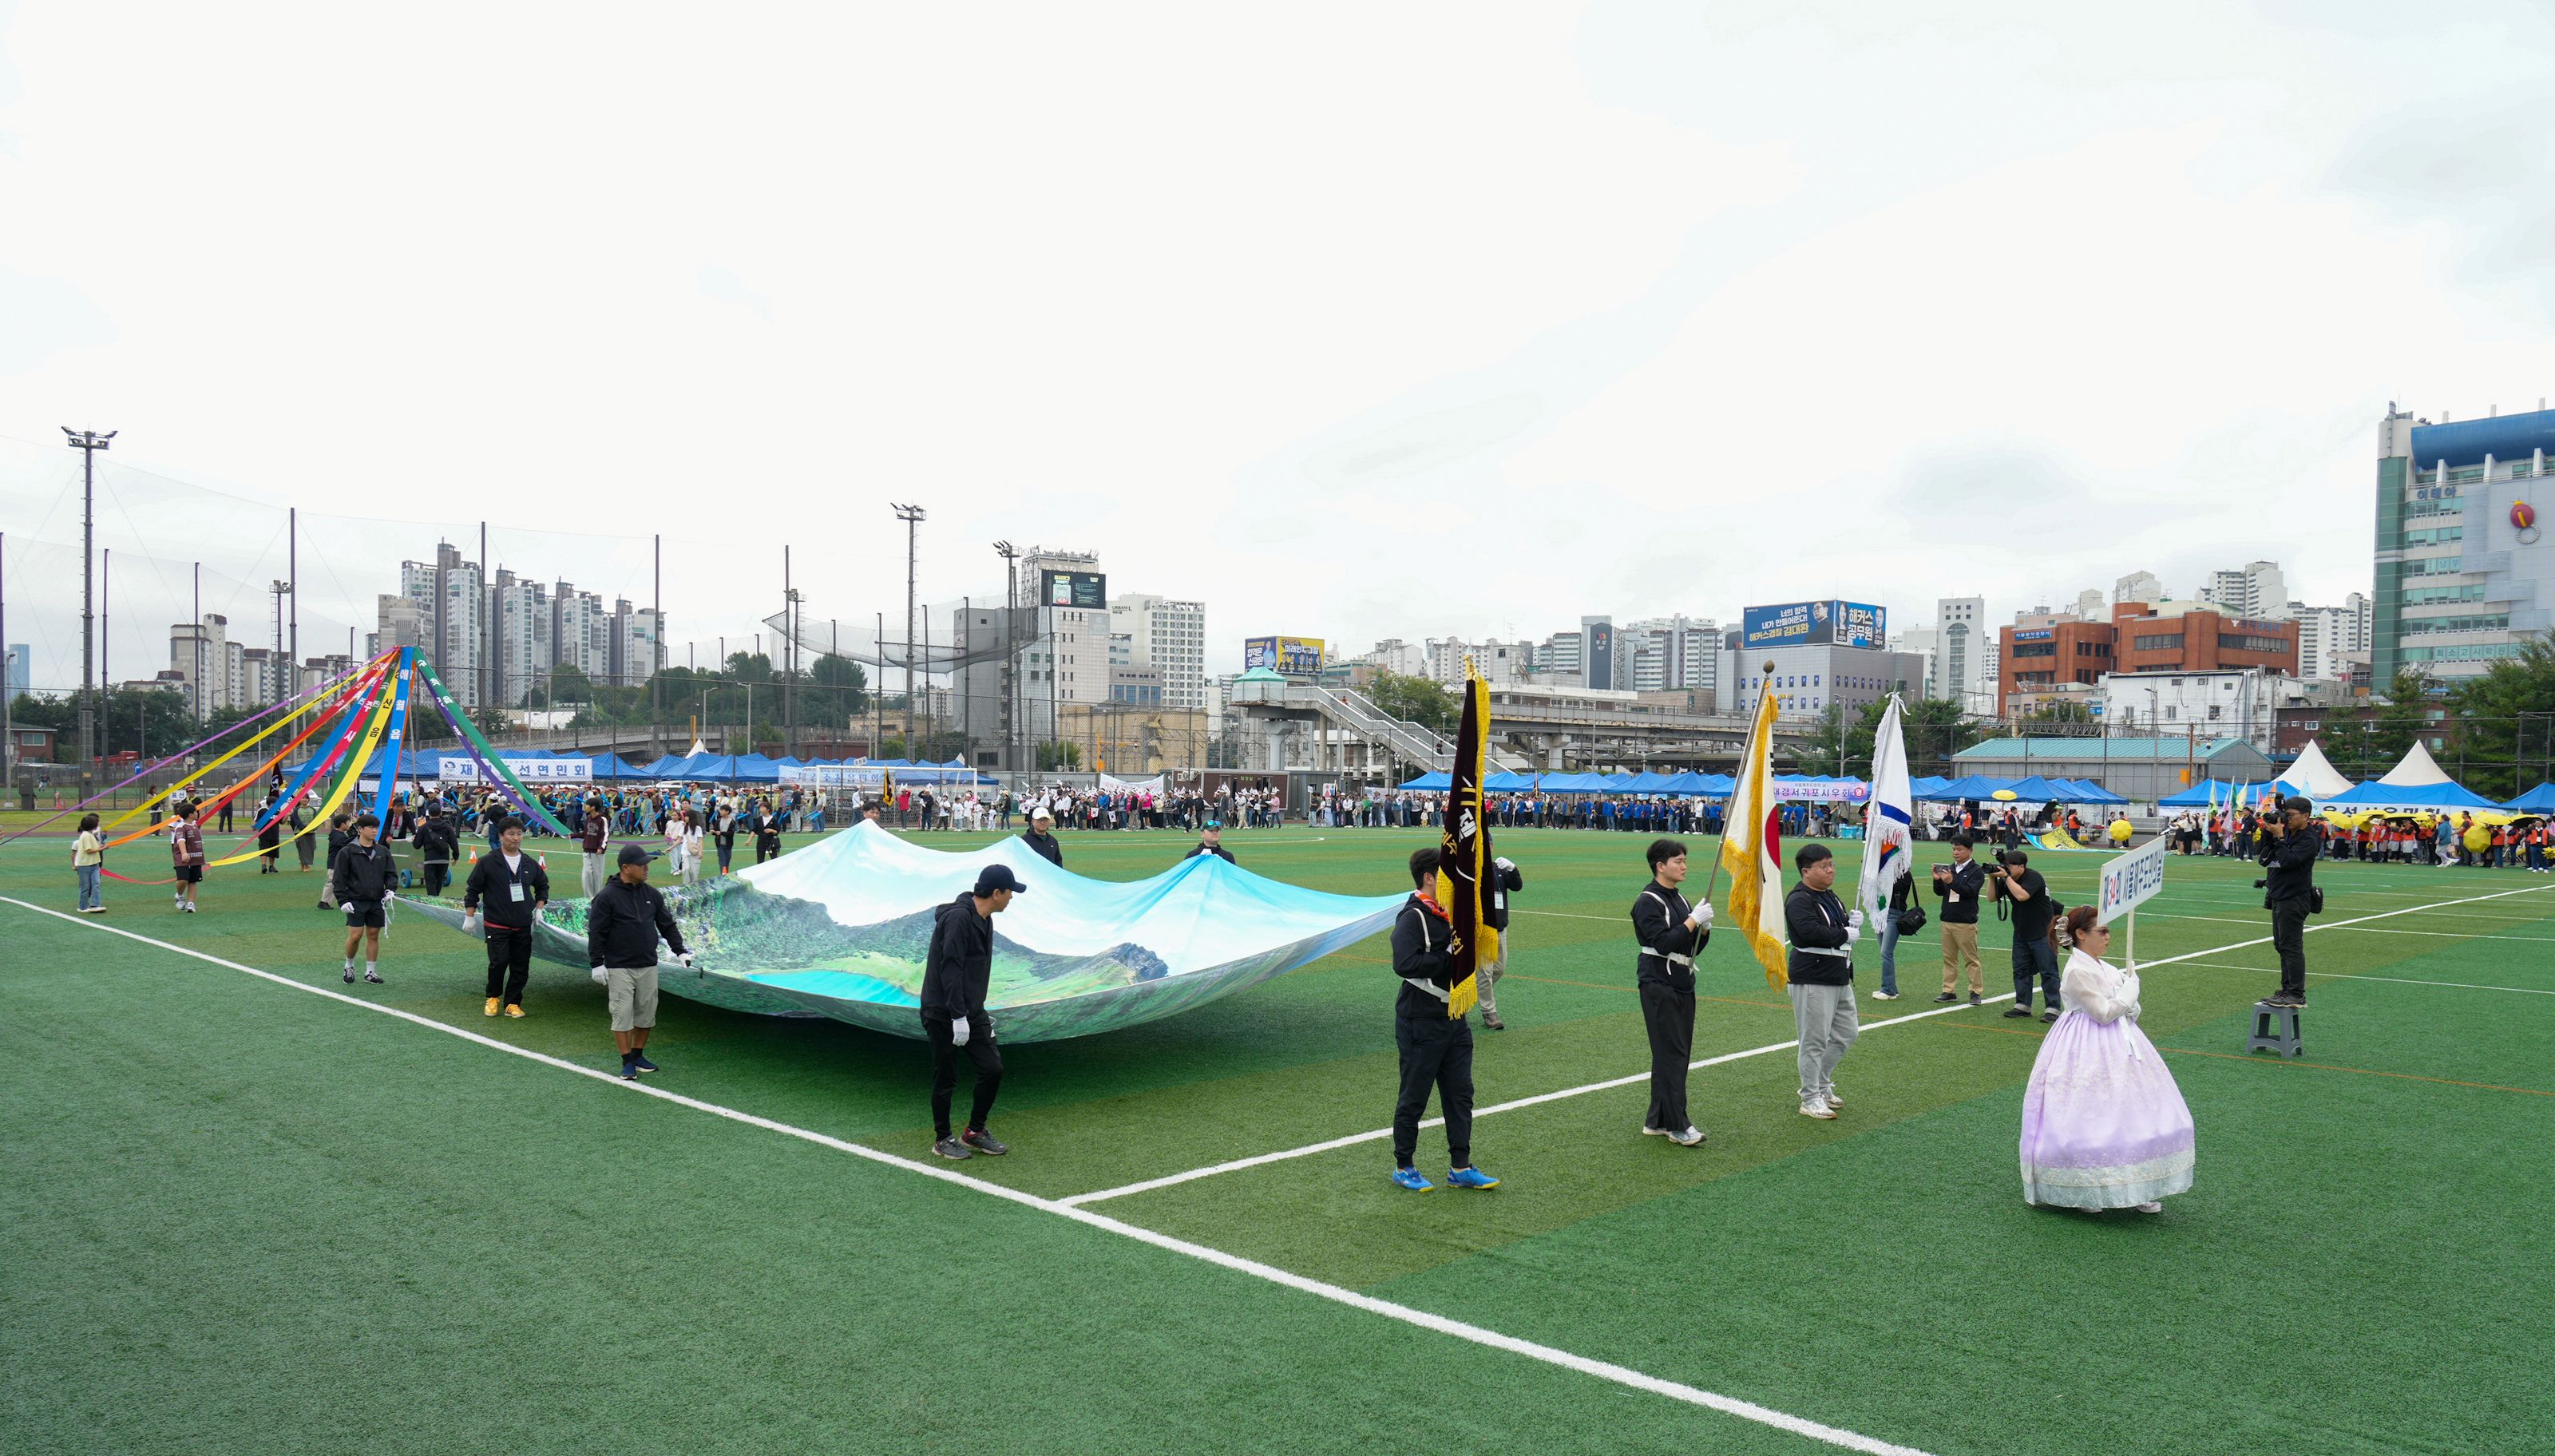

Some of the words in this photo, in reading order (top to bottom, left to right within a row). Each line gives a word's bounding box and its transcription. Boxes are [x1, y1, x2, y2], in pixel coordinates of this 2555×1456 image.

[1781, 608, 1793, 618] 너의
[1794, 605, 1808, 615] 합격
[1848, 608, 1874, 625] 해커스
[1761, 620, 1774, 630] 내가
[1848, 623, 1873, 642] 공무원
[1749, 627, 1783, 642] 해커스경찰
